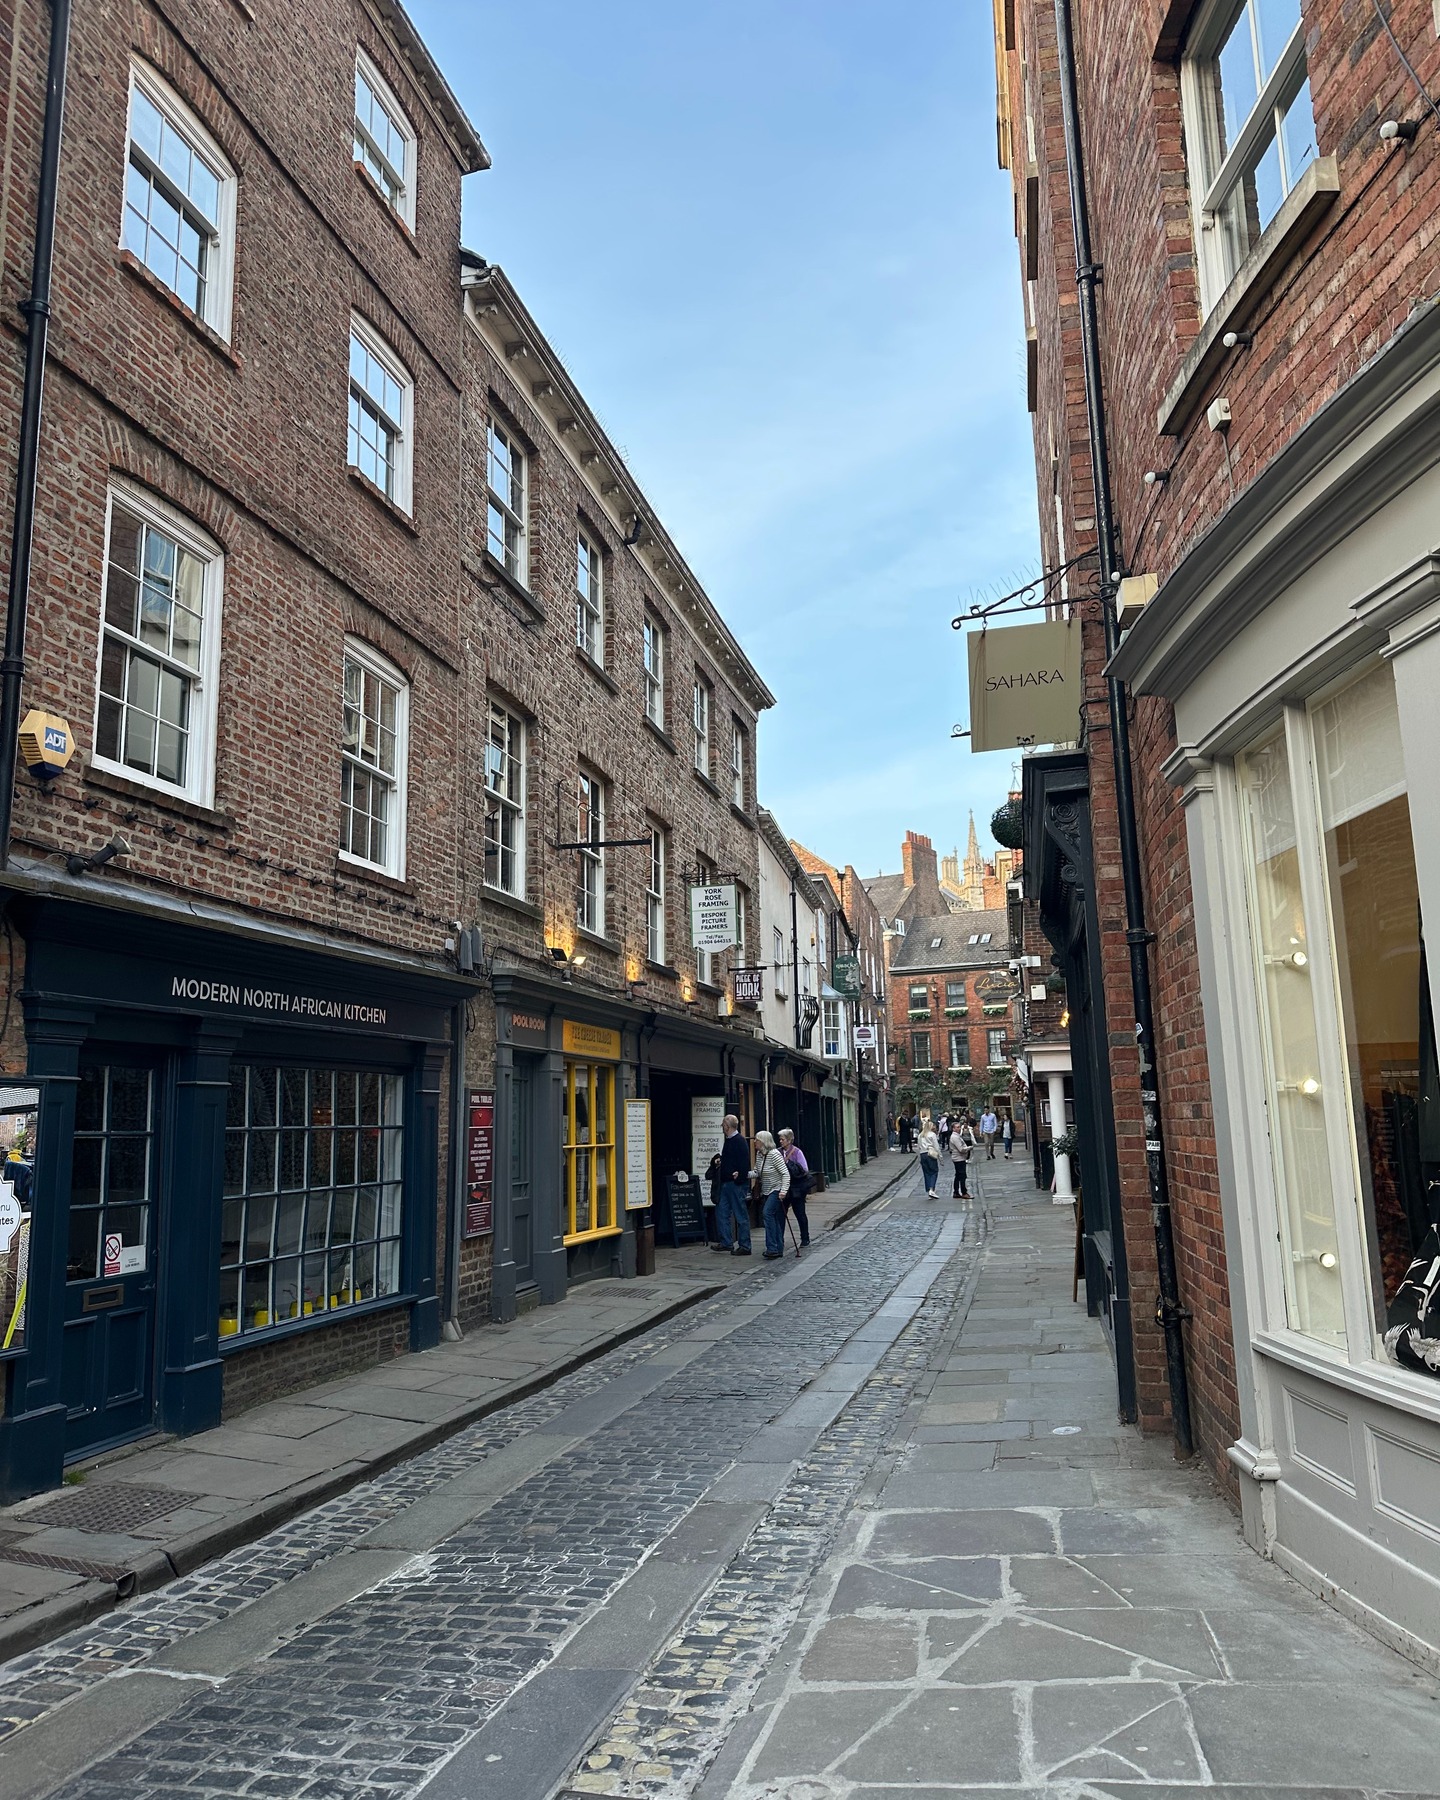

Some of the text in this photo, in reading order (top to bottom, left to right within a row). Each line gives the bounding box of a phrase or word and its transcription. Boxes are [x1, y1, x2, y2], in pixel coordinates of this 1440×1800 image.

[985, 669, 1064, 691] SAHARA
[45, 732, 66, 749] ADT
[698, 900, 729, 908] FRAMING
[735, 974, 760, 983] PIECE OF
[976, 977, 1018, 989] Lucia
[736, 982, 760, 996] YORK
[171, 976, 387, 1025] MODERN NORTH AFRICAN KITCHEN
[512, 1014, 546, 1031] POOL ROOM
